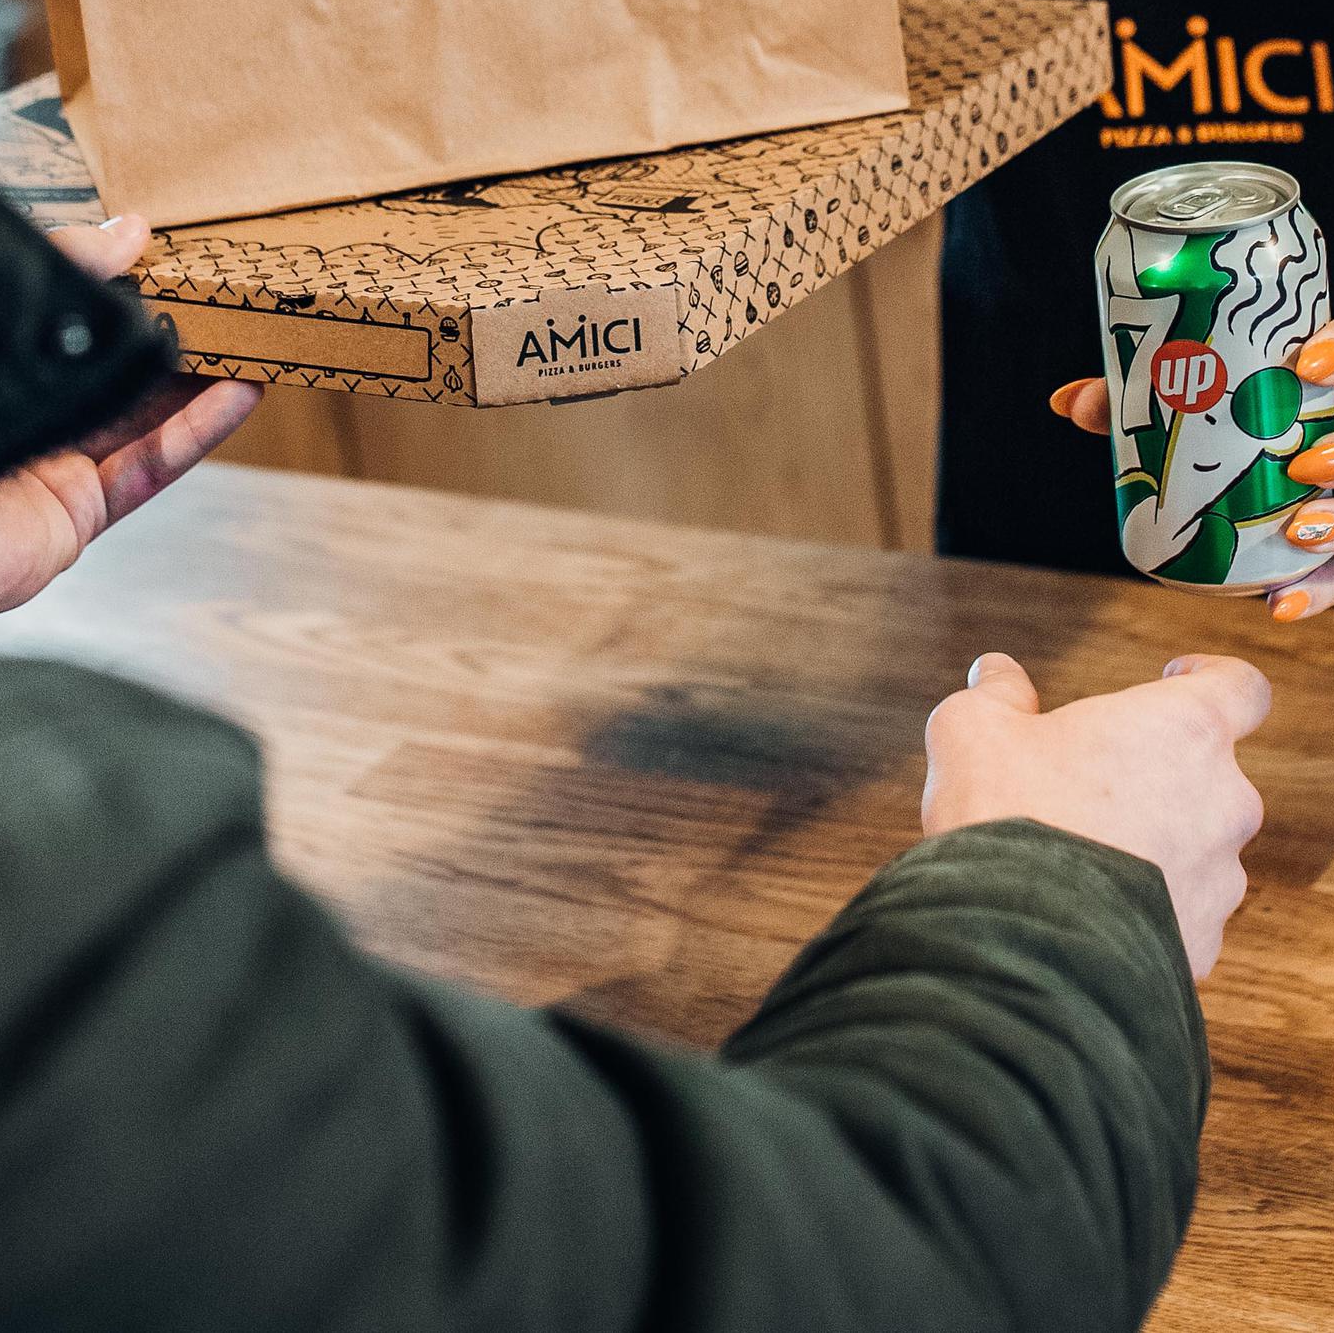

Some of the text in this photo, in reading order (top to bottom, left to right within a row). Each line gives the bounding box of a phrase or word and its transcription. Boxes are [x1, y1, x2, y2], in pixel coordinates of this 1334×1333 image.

[516, 314, 642, 367] AMICI
[538, 358, 622, 377] PIZZA & BURGERS
